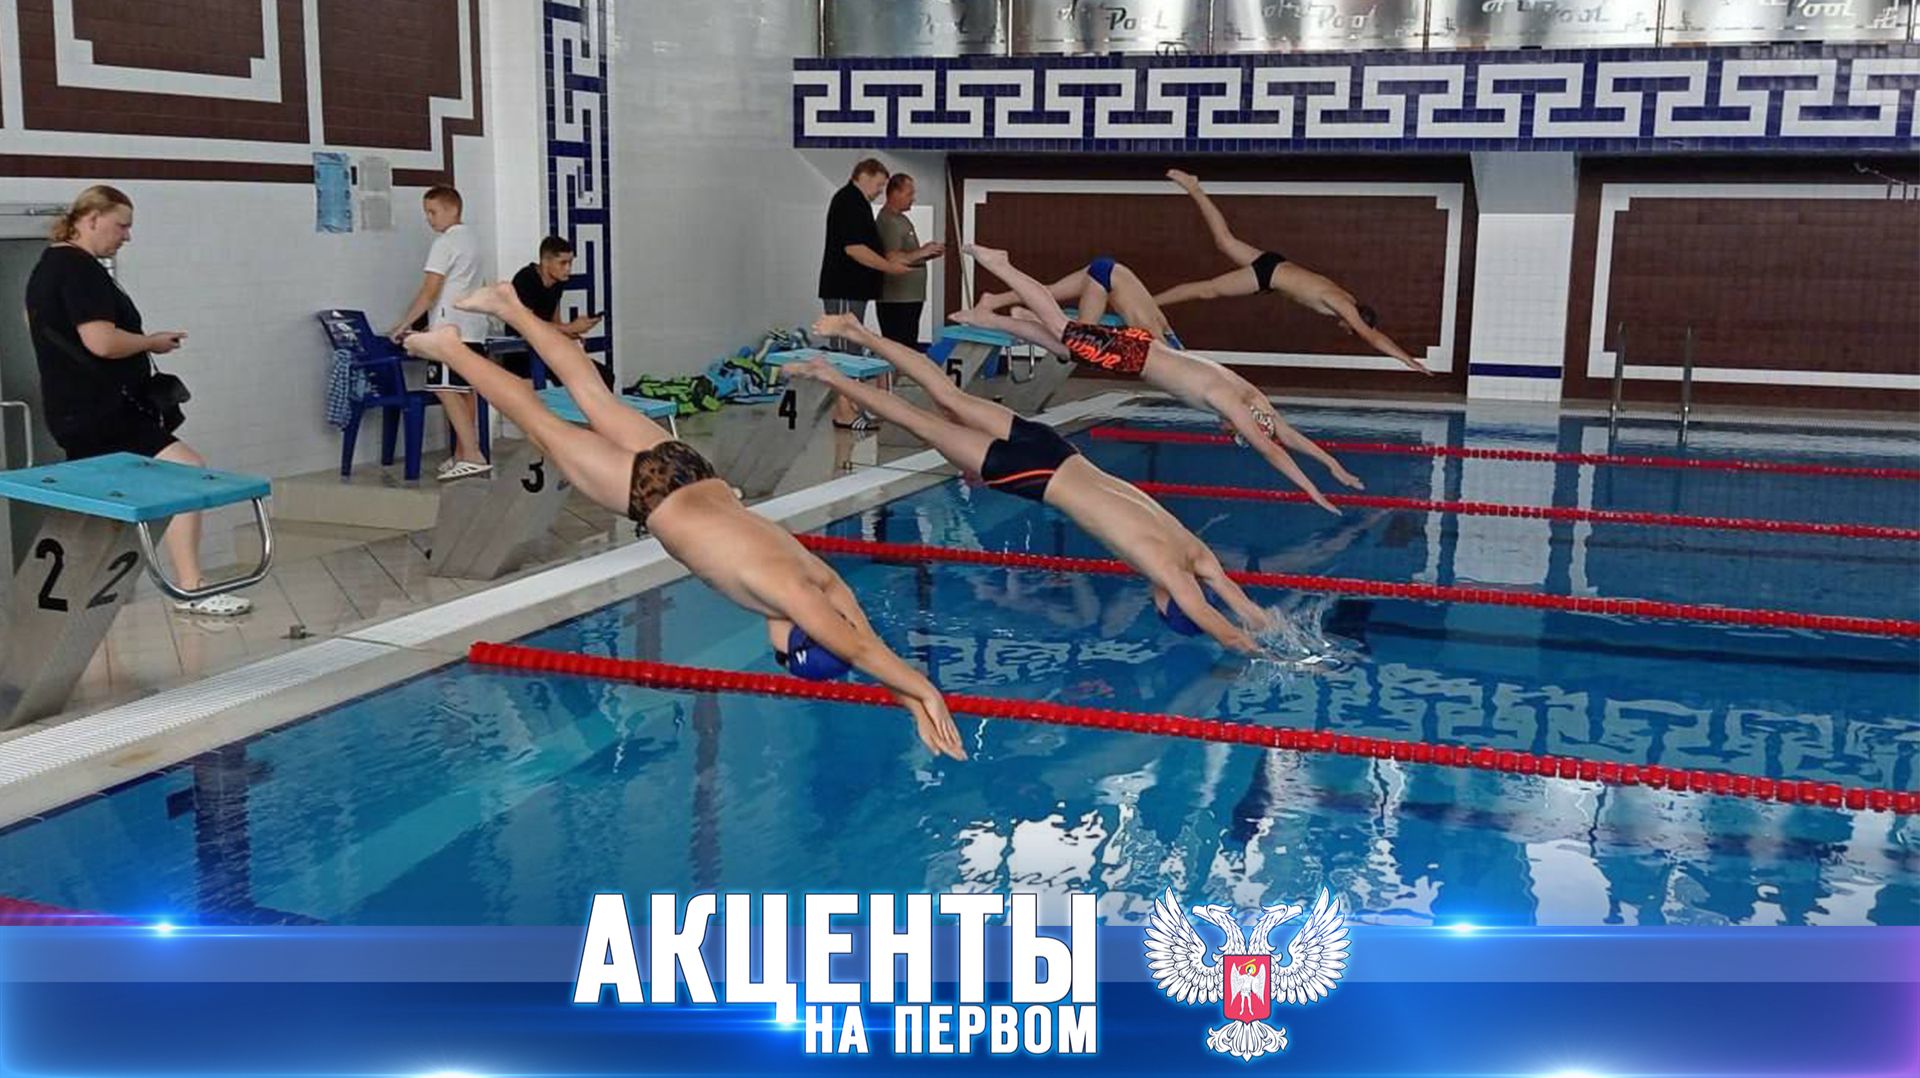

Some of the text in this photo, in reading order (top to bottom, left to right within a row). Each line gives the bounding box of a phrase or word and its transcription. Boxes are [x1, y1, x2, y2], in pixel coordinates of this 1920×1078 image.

[946, 358, 963, 388] 5
[779, 390, 797, 429] 4
[520, 456, 545, 493] 3
[36, 538, 68, 612] 2
[86, 551, 138, 610] 2
